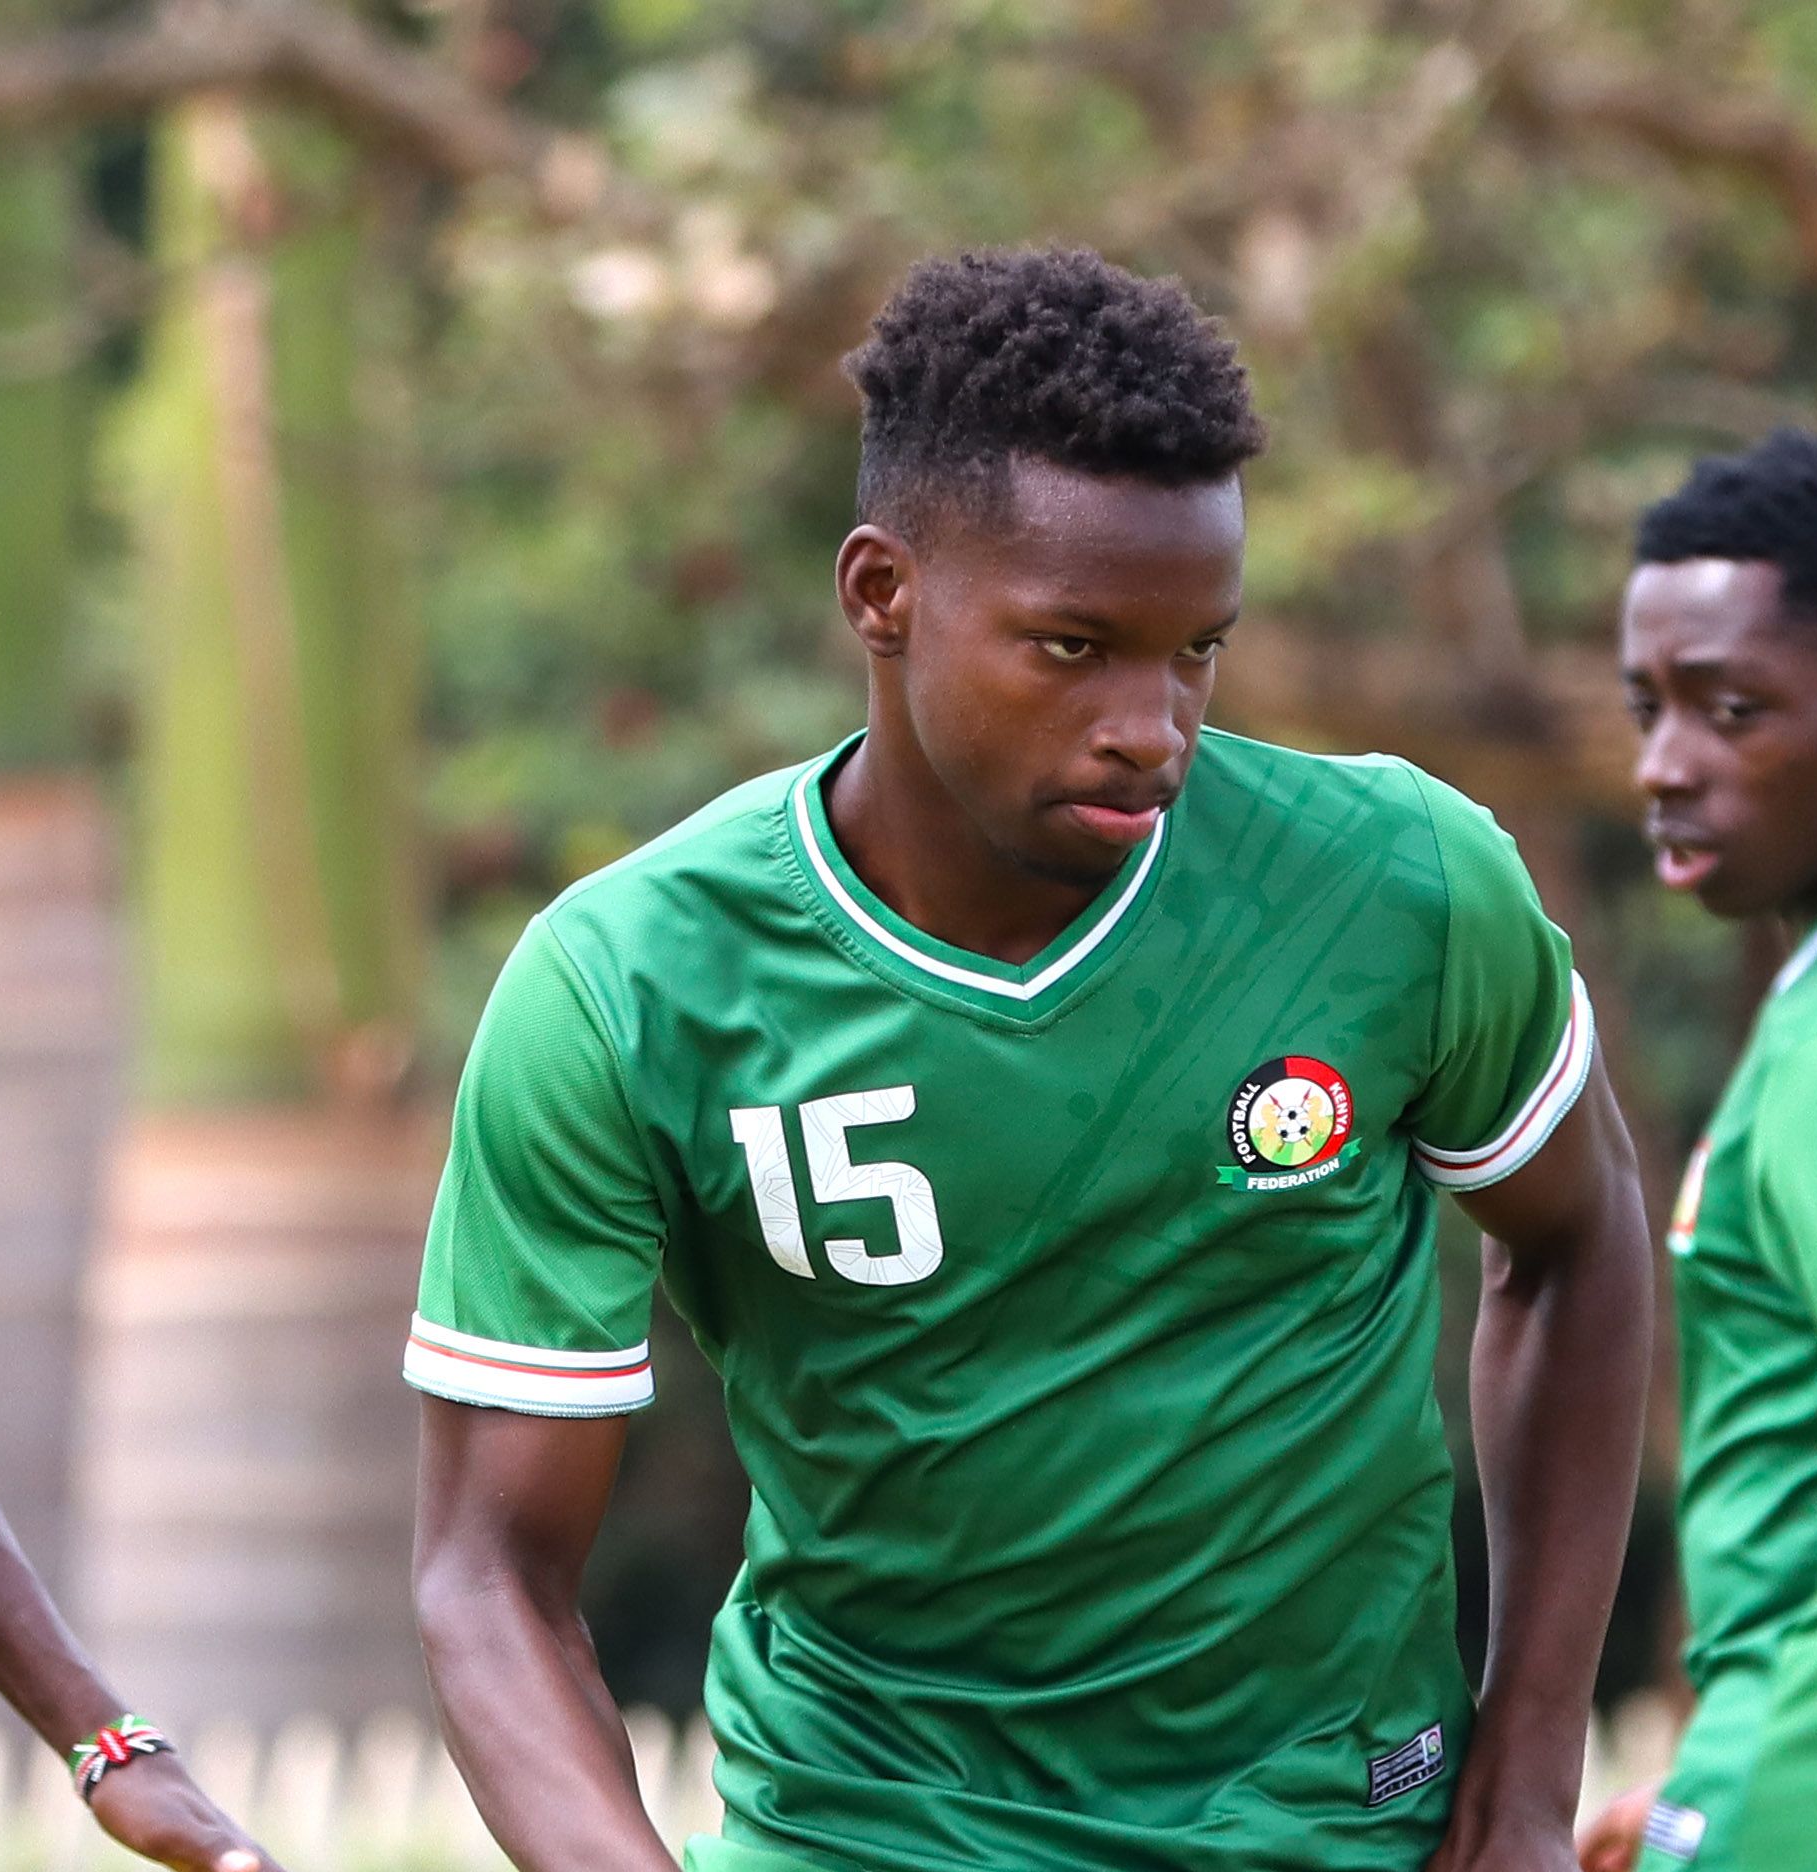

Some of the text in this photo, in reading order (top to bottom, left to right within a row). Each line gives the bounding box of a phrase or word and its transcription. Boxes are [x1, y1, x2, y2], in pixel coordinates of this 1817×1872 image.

[1231, 1081, 1262, 1165] FOOTBALL
[1329, 1081, 1352, 1136] KENYA
[728, 1084, 944, 1287] 15
[1246, 1158, 1340, 1190] FEDERATION
